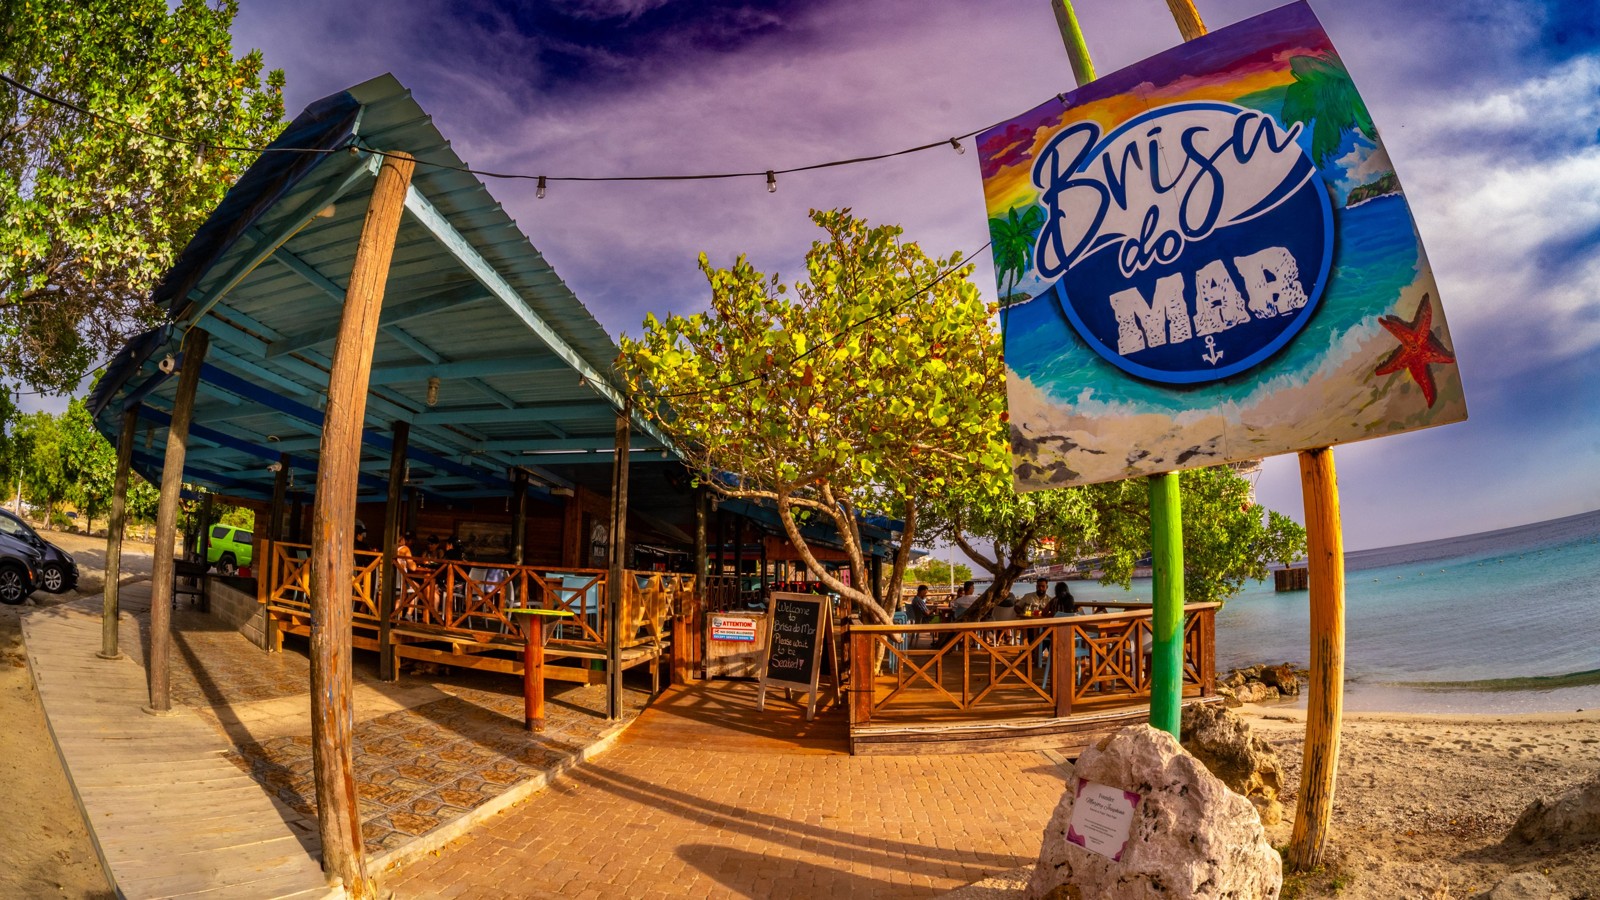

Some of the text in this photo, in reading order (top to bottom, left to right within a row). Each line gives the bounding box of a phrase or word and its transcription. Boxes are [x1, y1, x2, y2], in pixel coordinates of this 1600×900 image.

[1034, 113, 1302, 279] Brisa
[1121, 205, 1183, 275] do
[1109, 246, 1308, 355] MAR
[777, 601, 810, 616] Welcome
[788, 613, 796, 622] to
[774, 619, 815, 635] Brisa do Mar
[773, 633, 809, 648] Please wait
[778, 645, 796, 655] to be
